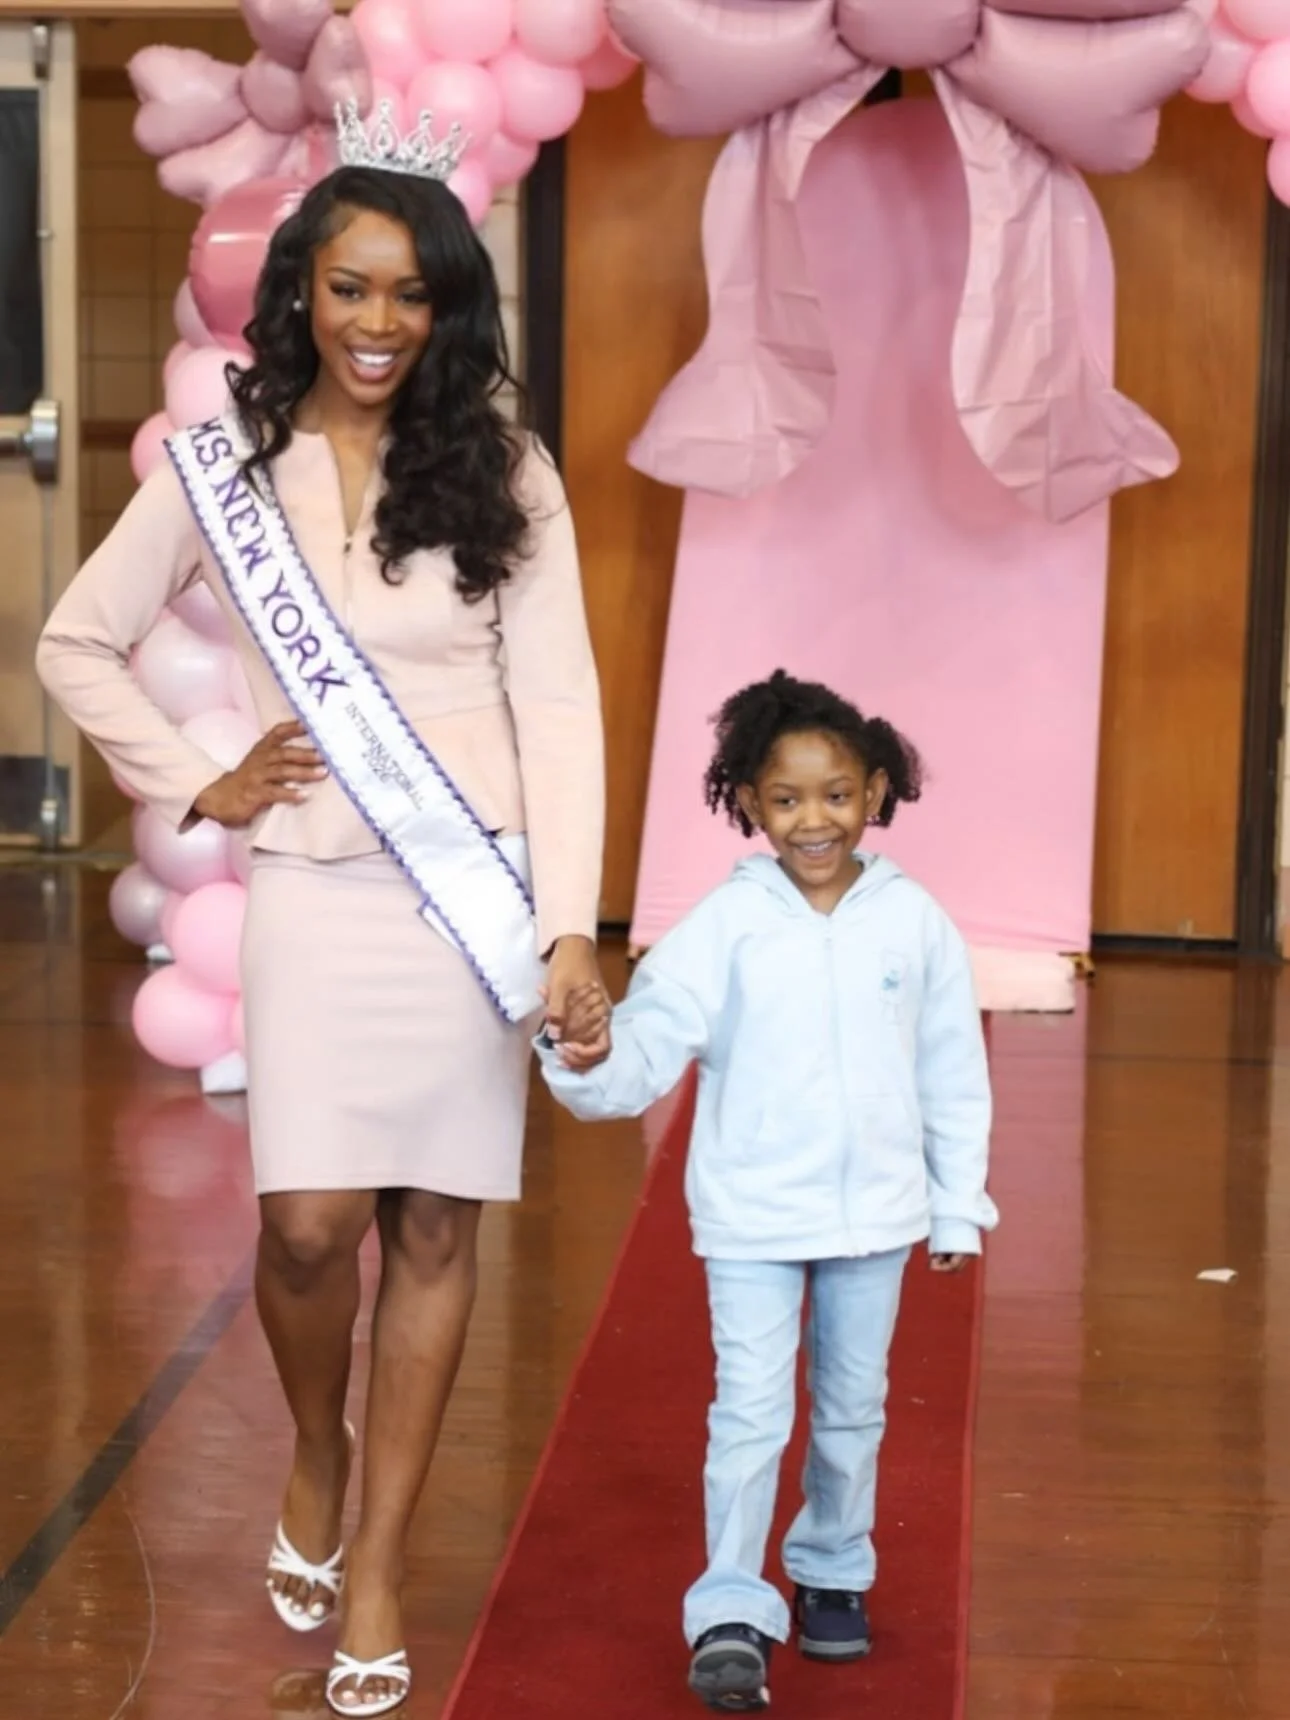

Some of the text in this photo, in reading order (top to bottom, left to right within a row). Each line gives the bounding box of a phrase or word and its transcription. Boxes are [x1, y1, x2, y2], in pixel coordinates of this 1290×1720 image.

[187, 416, 351, 706] MS. NEW YORK
[344, 701, 424, 811] INTERNATIONAL
